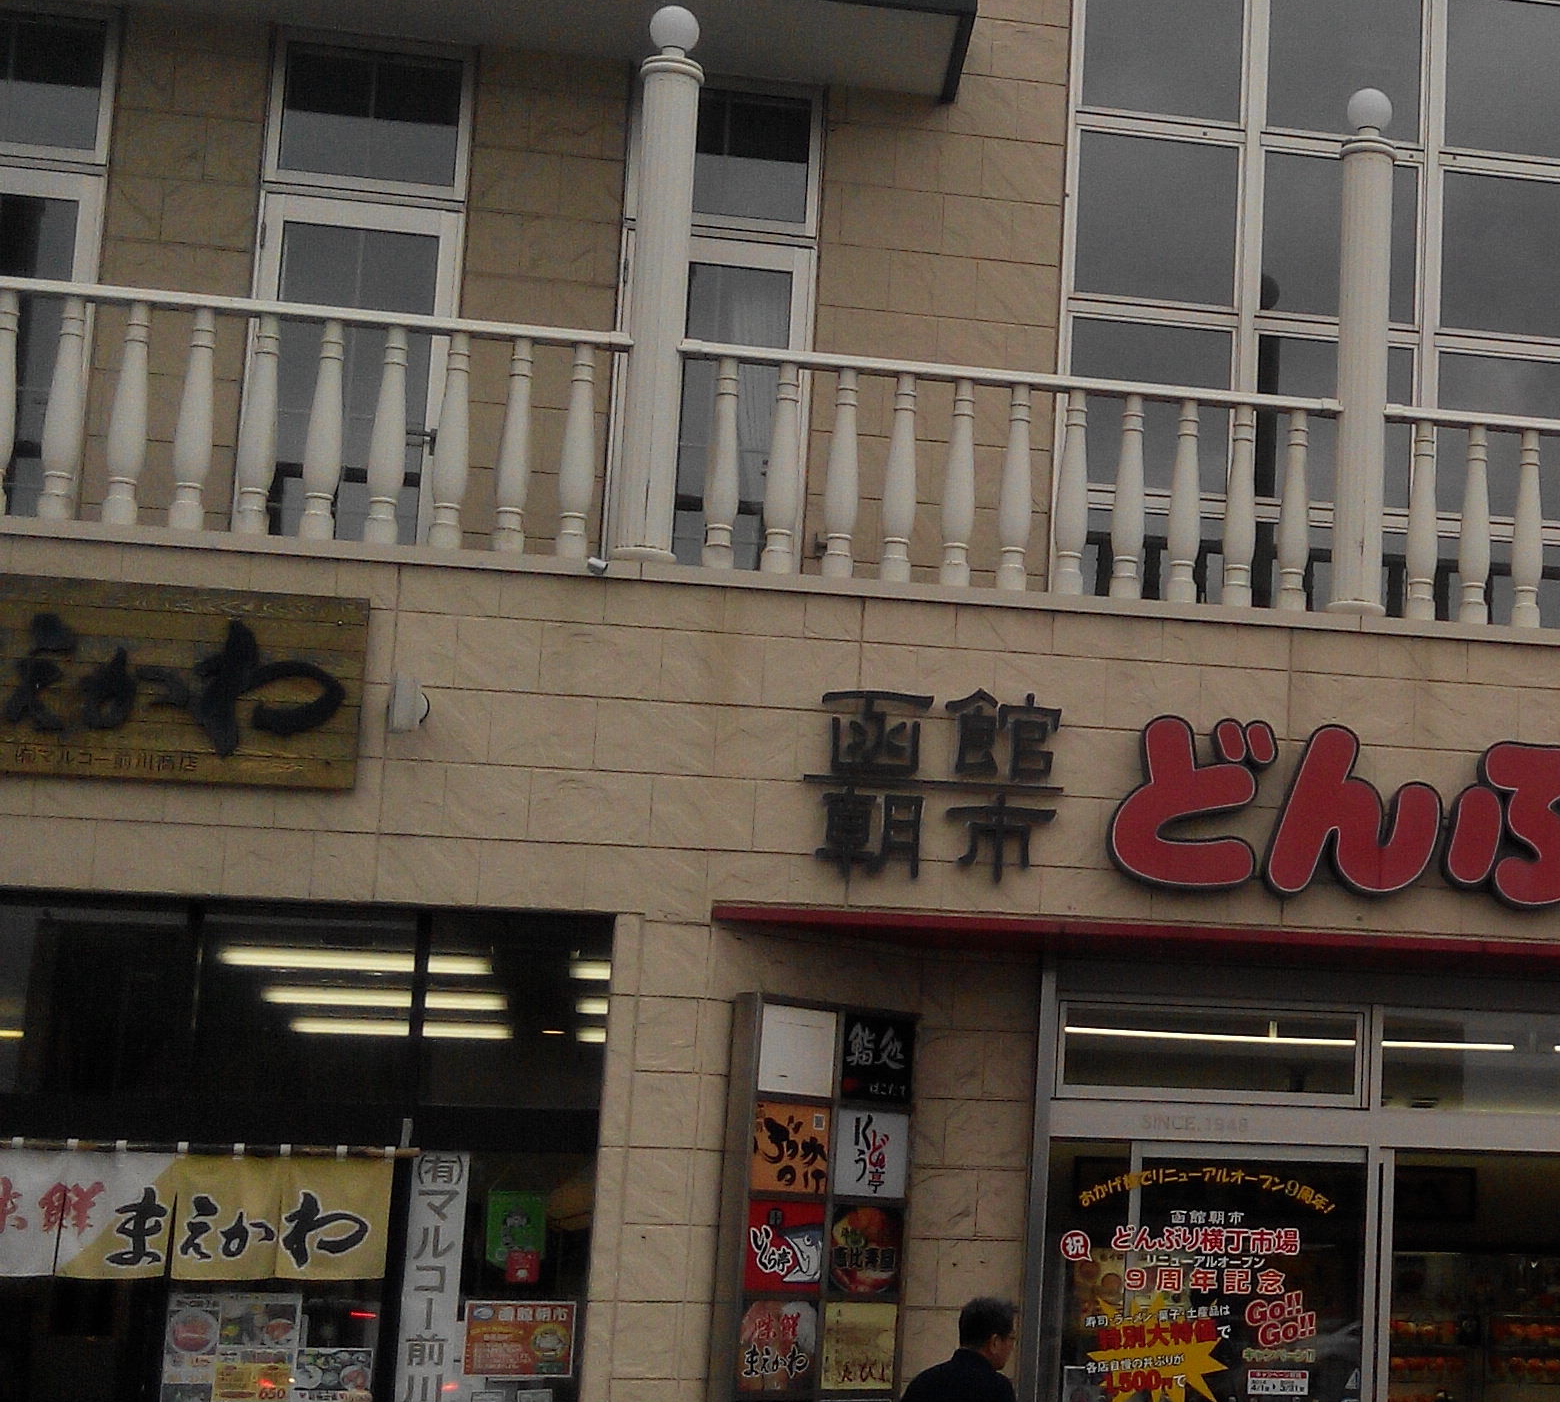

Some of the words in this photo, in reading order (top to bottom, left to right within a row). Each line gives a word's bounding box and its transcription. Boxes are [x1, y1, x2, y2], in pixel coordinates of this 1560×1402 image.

[821, 687, 1063, 781] 函館
[815, 785, 1058, 884] 朝市
[105, 1186, 369, 1269] まえかわ
[1169, 1209, 1245, 1225] 函館朝市
[1064, 1235, 1087, 1256] 祝
[1111, 1225, 1301, 1256] どんぶり横丁市場
[1146, 1254, 1266, 1269] リニューアルオープン
